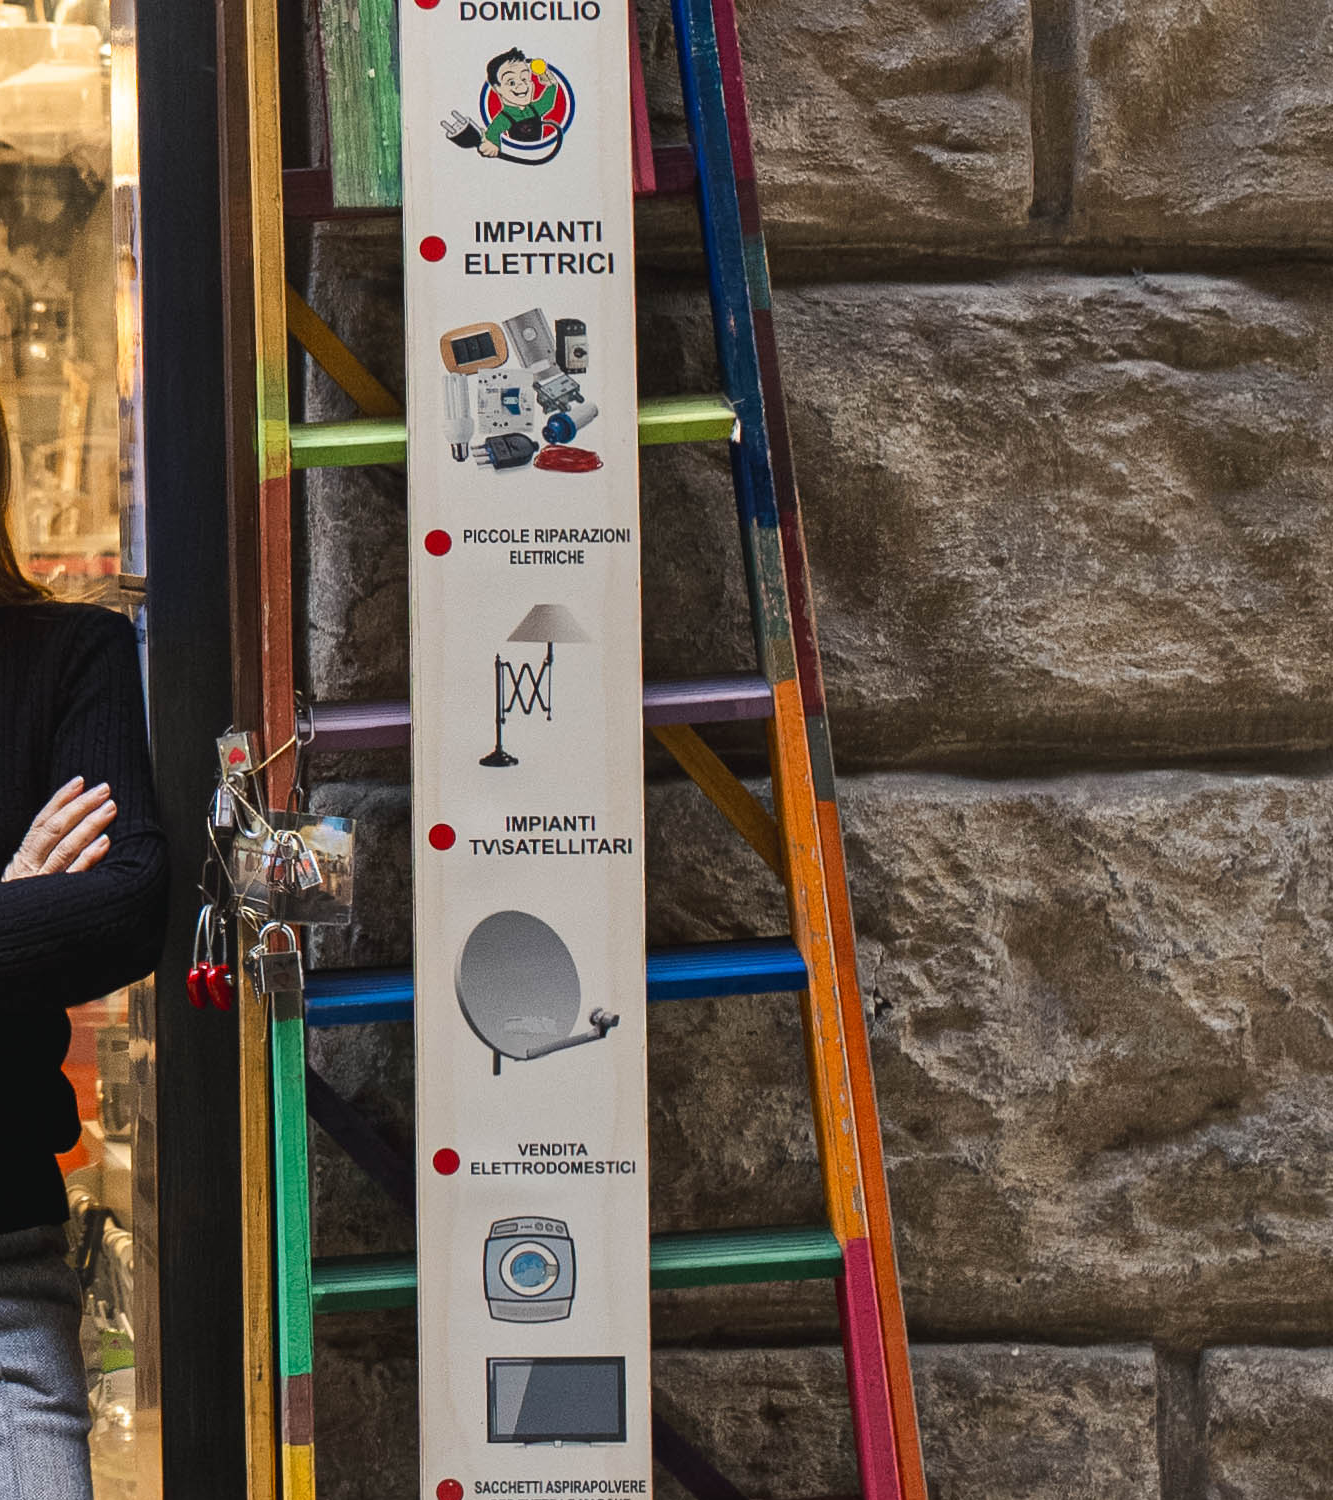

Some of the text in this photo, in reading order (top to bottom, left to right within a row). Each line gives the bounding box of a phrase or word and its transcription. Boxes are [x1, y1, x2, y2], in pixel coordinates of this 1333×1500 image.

[459, 0, 602, 22] DOMICILIO
[474, 220, 603, 244] IMPIANTI
[464, 252, 615, 276] ELETTRICI
[462, 528, 631, 545] PICCOLE RIPARAZIONI
[508, 549, 585, 566] ELETTRICHE
[505, 815, 597, 834] IMPIANTI
[469, 837, 634, 857] TV\SATELLITARI
[517, 1142, 589, 1158] VENDITA
[469, 1160, 637, 1177] ELETTRODOMESTICI
[473, 1479, 647, 1497] SACCHETTI ASPIRAPOLVERE
